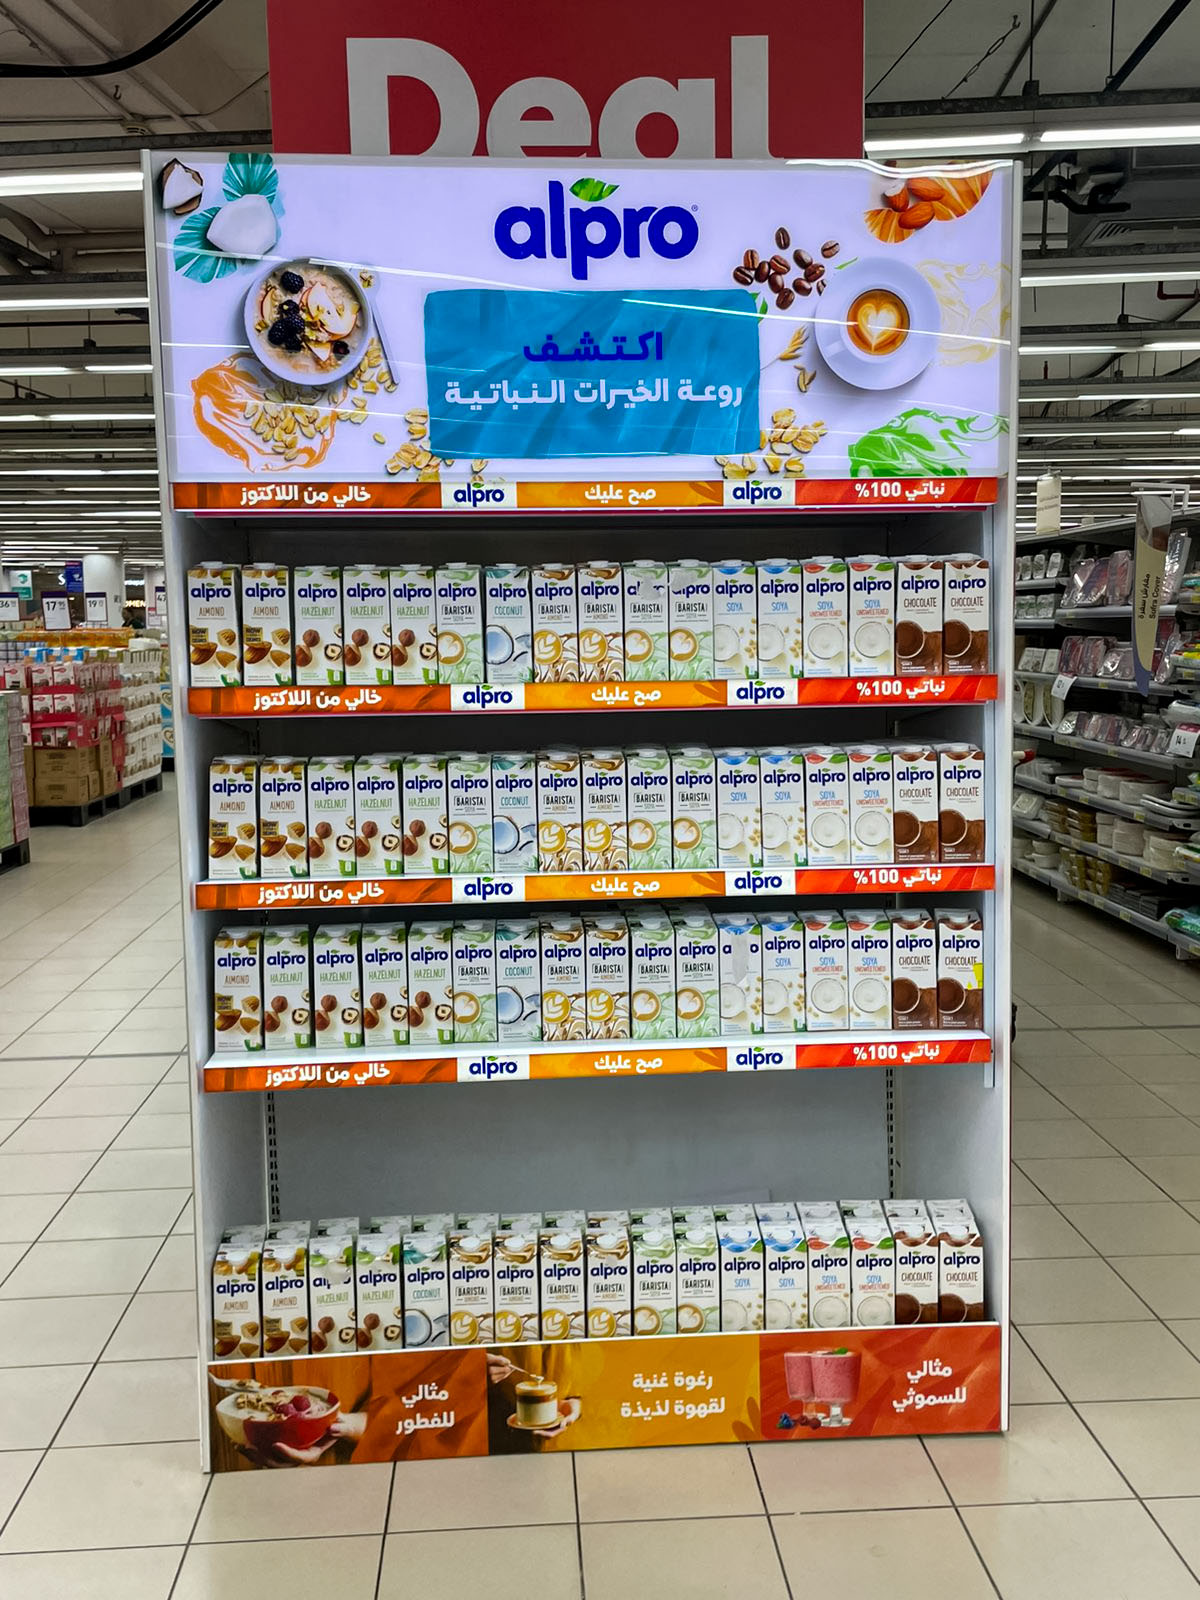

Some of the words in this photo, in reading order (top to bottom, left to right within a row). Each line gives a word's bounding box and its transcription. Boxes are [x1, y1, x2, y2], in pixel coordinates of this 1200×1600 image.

[346, 34, 787, 158] Deal
[523, 331, 662, 361] اكتشف
[444, 379, 565, 410] النباتية
[574, 378, 669, 410] الخيرات
[677, 379, 743, 407] روعة
[240, 485, 299, 505] اللاكتوز
[303, 487, 329, 504] من
[334, 485, 371, 508] خالي
[453, 484, 504, 507] alpro
[585, 485, 624, 503] عليك
[628, 487, 657, 505] صح
[733, 482, 782, 504] alpro
[905, 482, 945, 501] نباتي
[191, 583, 231, 601] alpro
[298, 583, 338, 601] alpro
[347, 583, 387, 601] alpro
[438, 583, 477, 601] alpro
[489, 583, 527, 601] alpro
[535, 582, 573, 600] alpro
[581, 581, 619, 599] alpro
[715, 579, 754, 597] alpro
[853, 576, 892, 595] alpro
[901, 575, 940, 593] alpro
[1152, 576, 1161, 598] Cover
[45, 602, 57, 611] 17
[301, 606, 335, 616] HAZELNUT
[350, 606, 384, 616] HAZELNUT
[494, 605, 523, 616] COCONUT
[726, 602, 743, 612] SOYA
[864, 600, 880, 609] SOYA
[904, 597, 937, 608] CHOCOLATE
[316, 688, 340, 707] من
[463, 685, 513, 708] alpro
[591, 686, 630, 705] عليك
[634, 689, 661, 706] صح
[736, 681, 784, 704] alpro
[905, 680, 945, 699] نباتي
[254, 690, 311, 710] اللاكتوز
[345, 689, 382, 711] خالي
[495, 774, 533, 792] alpro
[540, 773, 578, 791] alpro
[630, 772, 668, 789] alpro
[675, 771, 713, 788] alpro
[720, 770, 757, 787] alpro
[896, 767, 934, 784] alpro
[943, 766, 981, 783] alpro
[213, 779, 253, 796] alpro
[262, 778, 302, 796] alpro
[357, 777, 395, 794] alpro
[405, 776, 443, 793] alpro
[451, 775, 489, 792] alpro
[946, 787, 979, 797] CHOCOLATE
[408, 796, 440, 807] HAZELNUT
[501, 796, 529, 806] COCONUT
[730, 792, 747, 801] SOYA
[900, 788, 932, 798] CHOCOLATE
[360, 798, 393, 808] HAZELNUT
[734, 871, 782, 893] alpro
[902, 868, 942, 887] نباتي
[258, 884, 314, 904] اللاكتوز
[319, 885, 343, 900] من
[348, 882, 384, 904] خالي
[464, 877, 513, 900] alpro
[591, 878, 629, 895] عليك
[632, 880, 660, 896] صح
[635, 943, 672, 960] alpro
[679, 942, 717, 959] alpro
[765, 936, 801, 953] alpro
[851, 935, 888, 952] alpro
[896, 935, 933, 952] alpro
[266, 951, 306, 969] alpro
[316, 950, 355, 967] alpro
[455, 945, 493, 962] alpro
[500, 945, 537, 962] alpro
[544, 944, 582, 961] alpro
[899, 956, 931, 965] CHOCOLATE
[217, 953, 257, 970] alpro
[775, 958, 791, 967] SOYA
[862, 957, 877, 966] SOYA
[270, 972, 303, 983] HAZELNUT
[320, 971, 352, 981] HAZELNUT
[505, 966, 532, 977] COCONUT
[736, 1047, 784, 1069] alpro
[901, 1043, 940, 1062] نباتي
[469, 1057, 518, 1079] alpro
[594, 1054, 631, 1072] عليك
[635, 1057, 663, 1073] صح
[265, 1065, 321, 1087] اللاكتوز
[325, 1066, 350, 1081] من
[353, 1063, 390, 1084] خالي
[679, 1258, 716, 1275] alpro
[724, 1257, 761, 1274] alpro
[899, 1252, 935, 1268] alpro
[943, 1251, 980, 1268] alpro
[407, 1268, 445, 1285] alpro
[452, 1265, 490, 1282] alpro
[544, 1263, 581, 1280] alpro
[637, 1260, 673, 1277] alpro
[901, 1272, 933, 1281] CHOCOLATE
[946, 1272, 978, 1281] CHOCOLATE
[265, 1276, 304, 1293] alpro
[359, 1270, 397, 1287] alpro
[734, 1278, 750, 1287] SOYA
[216, 1280, 255, 1297] alpro
[906, 1359, 953, 1383] مثالي
[633, 1372, 670, 1391] غنية
[674, 1372, 714, 1391] رغوة
[401, 1382, 448, 1407] مثالي
[892, 1385, 967, 1413] للسموثي
[621, 1398, 670, 1419] لذيذة
[674, 1395, 726, 1418] لقهوة
[396, 1411, 455, 1435] للفطور
